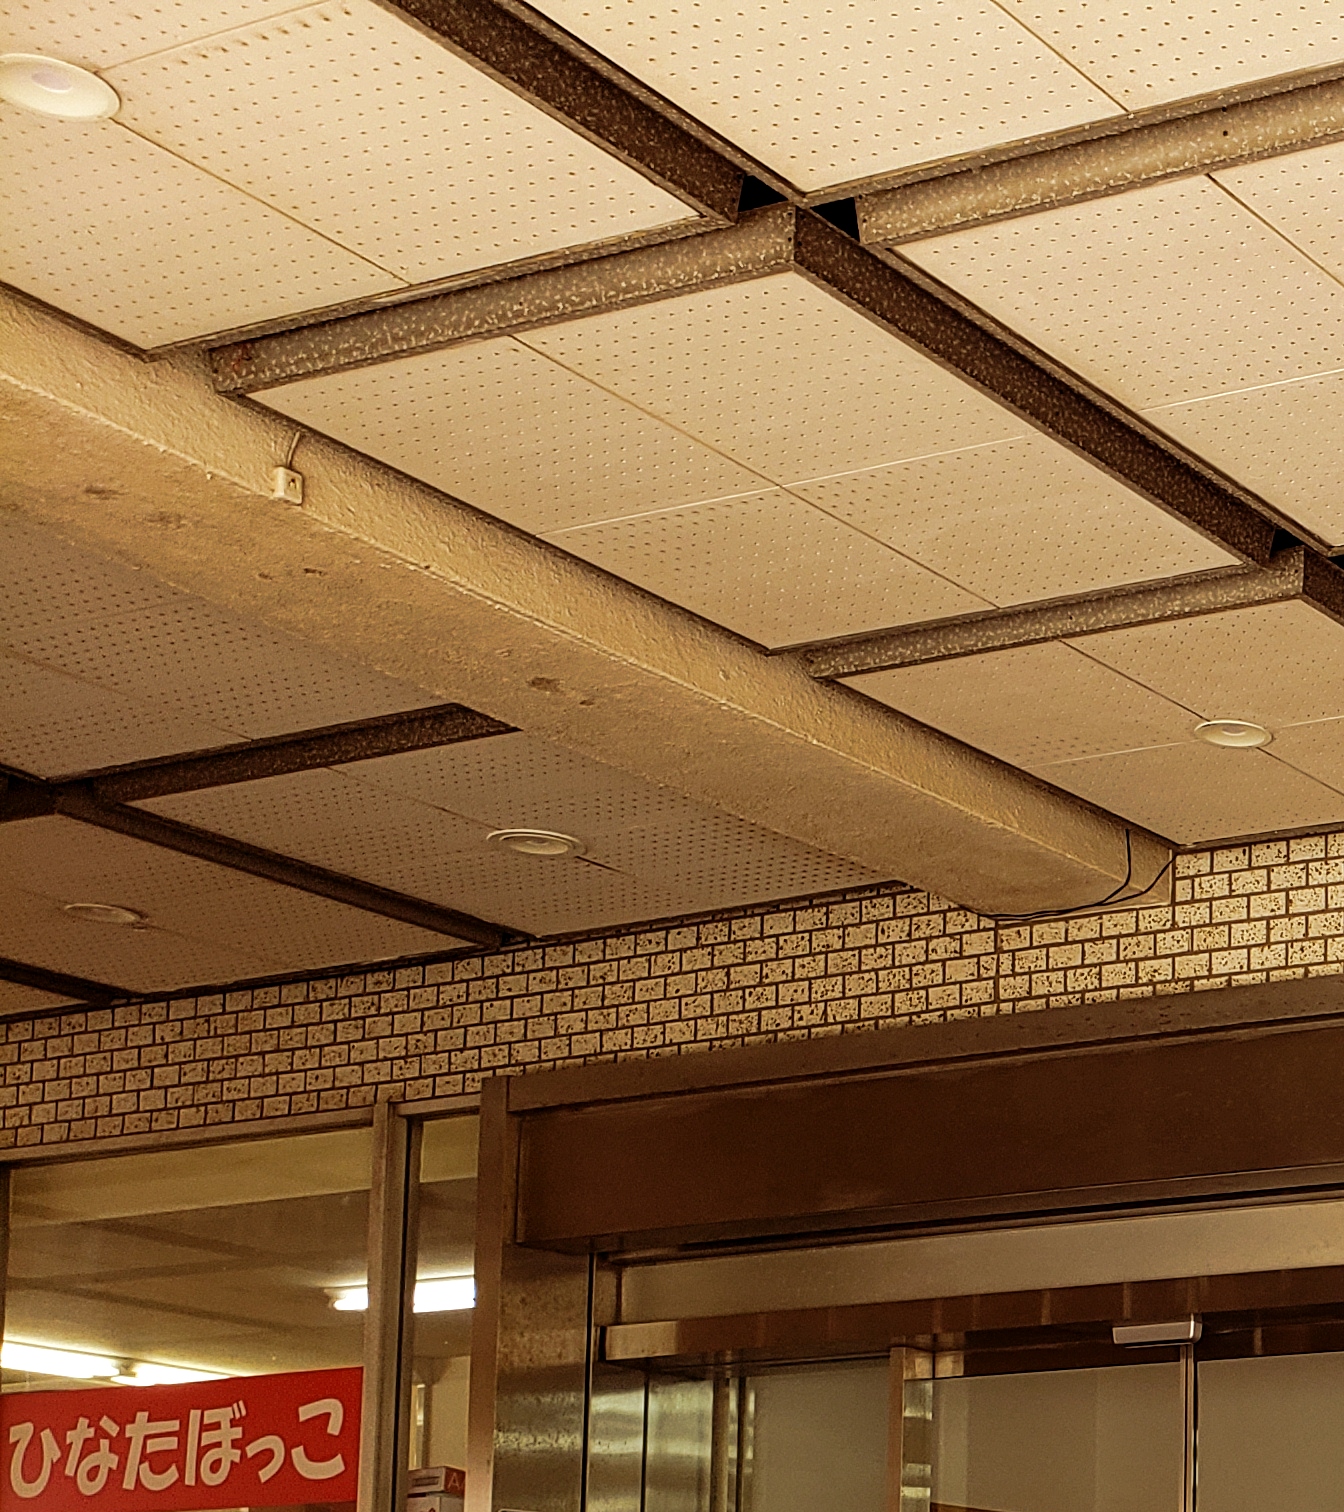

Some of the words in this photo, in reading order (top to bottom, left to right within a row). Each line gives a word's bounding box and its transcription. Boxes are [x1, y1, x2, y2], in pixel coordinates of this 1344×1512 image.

[9, 1398, 346, 1498] ひなたぼっこ
